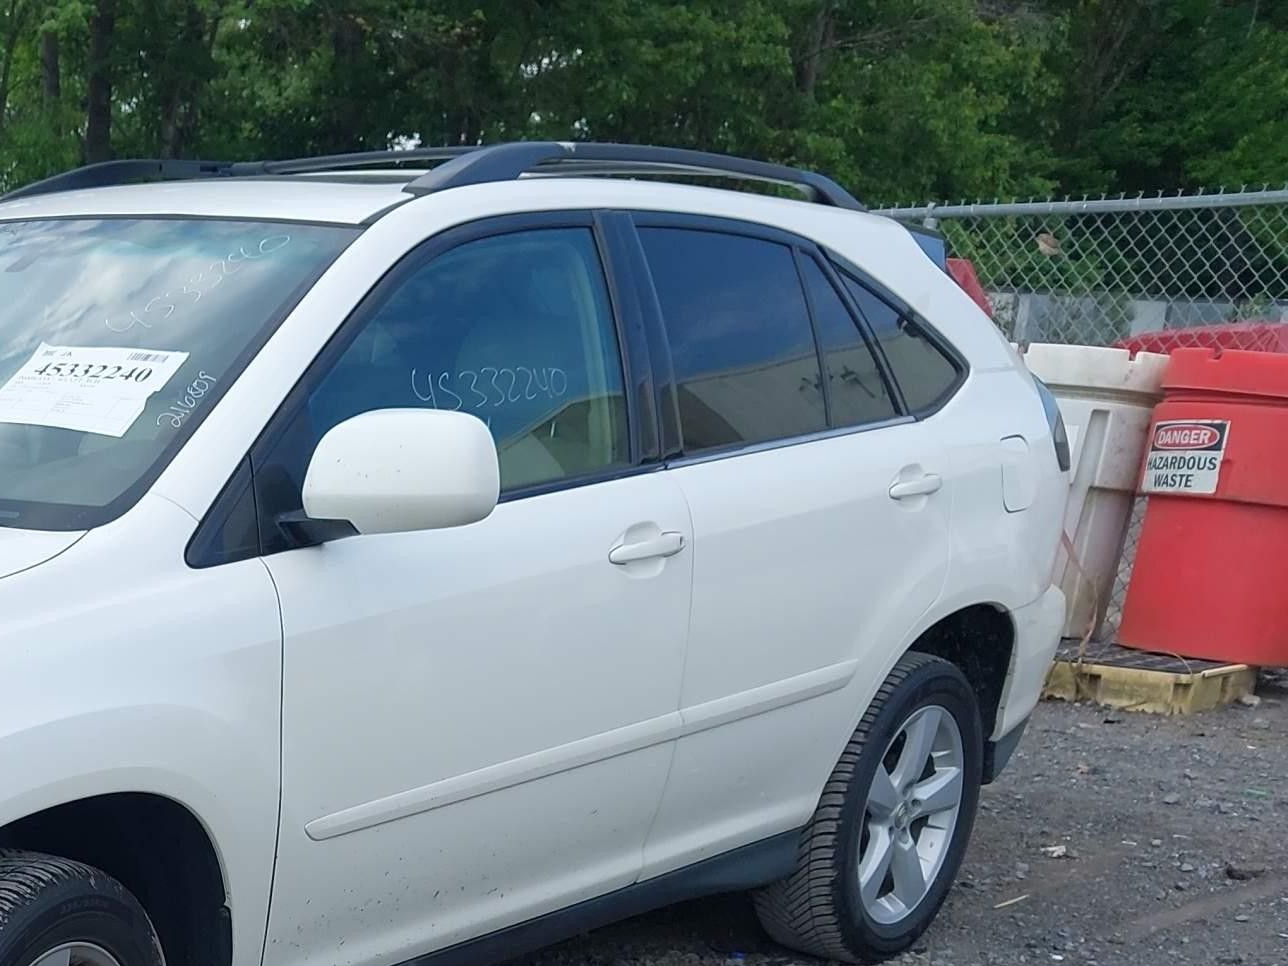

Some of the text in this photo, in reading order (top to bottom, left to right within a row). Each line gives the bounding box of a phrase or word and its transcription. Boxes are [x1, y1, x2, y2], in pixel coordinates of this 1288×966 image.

[34, 361, 153, 383] 45332240
[411, 367, 568, 411] 45332240
[1157, 429, 1212, 445] DANGER
[1147, 456, 1218, 471] HAZARDOUS
[1153, 473, 1195, 488] WASTE
